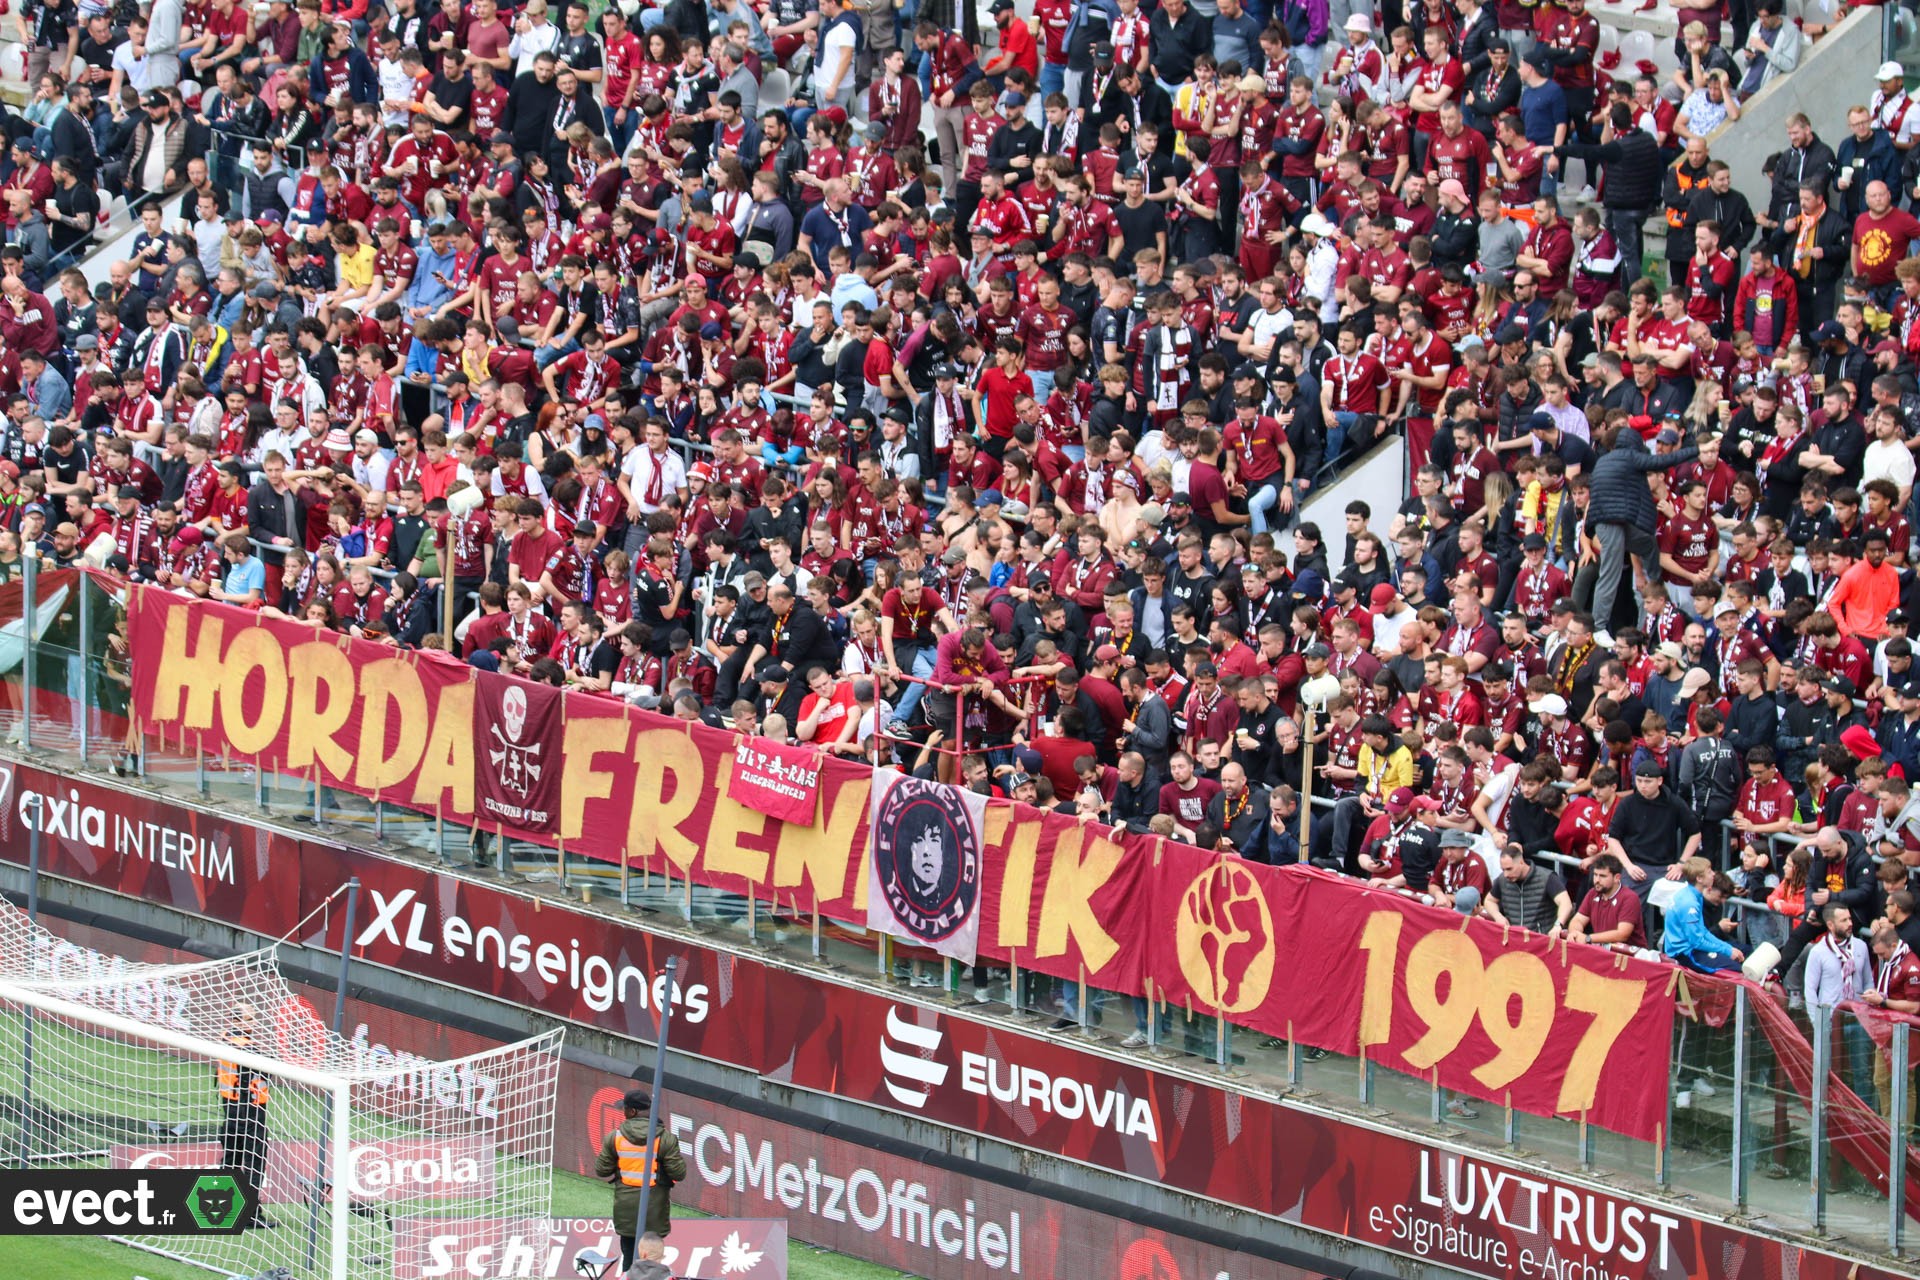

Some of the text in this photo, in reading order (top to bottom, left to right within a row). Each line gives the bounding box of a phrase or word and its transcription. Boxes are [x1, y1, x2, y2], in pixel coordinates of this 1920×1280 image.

[19, 788, 235, 886] axia INTERIM
[152, 604, 1648, 1114] HORDA FRENIK 1997
[886, 870, 964, 935] YOUTH
[356, 888, 709, 1023] XL enseignes
[962, 1050, 1158, 1143] EUROVIA
[350, 1146, 479, 1197] Carola
[1420, 1150, 1679, 1271] LUXTRUST
[538, 1218, 616, 1234] AUTOCA
